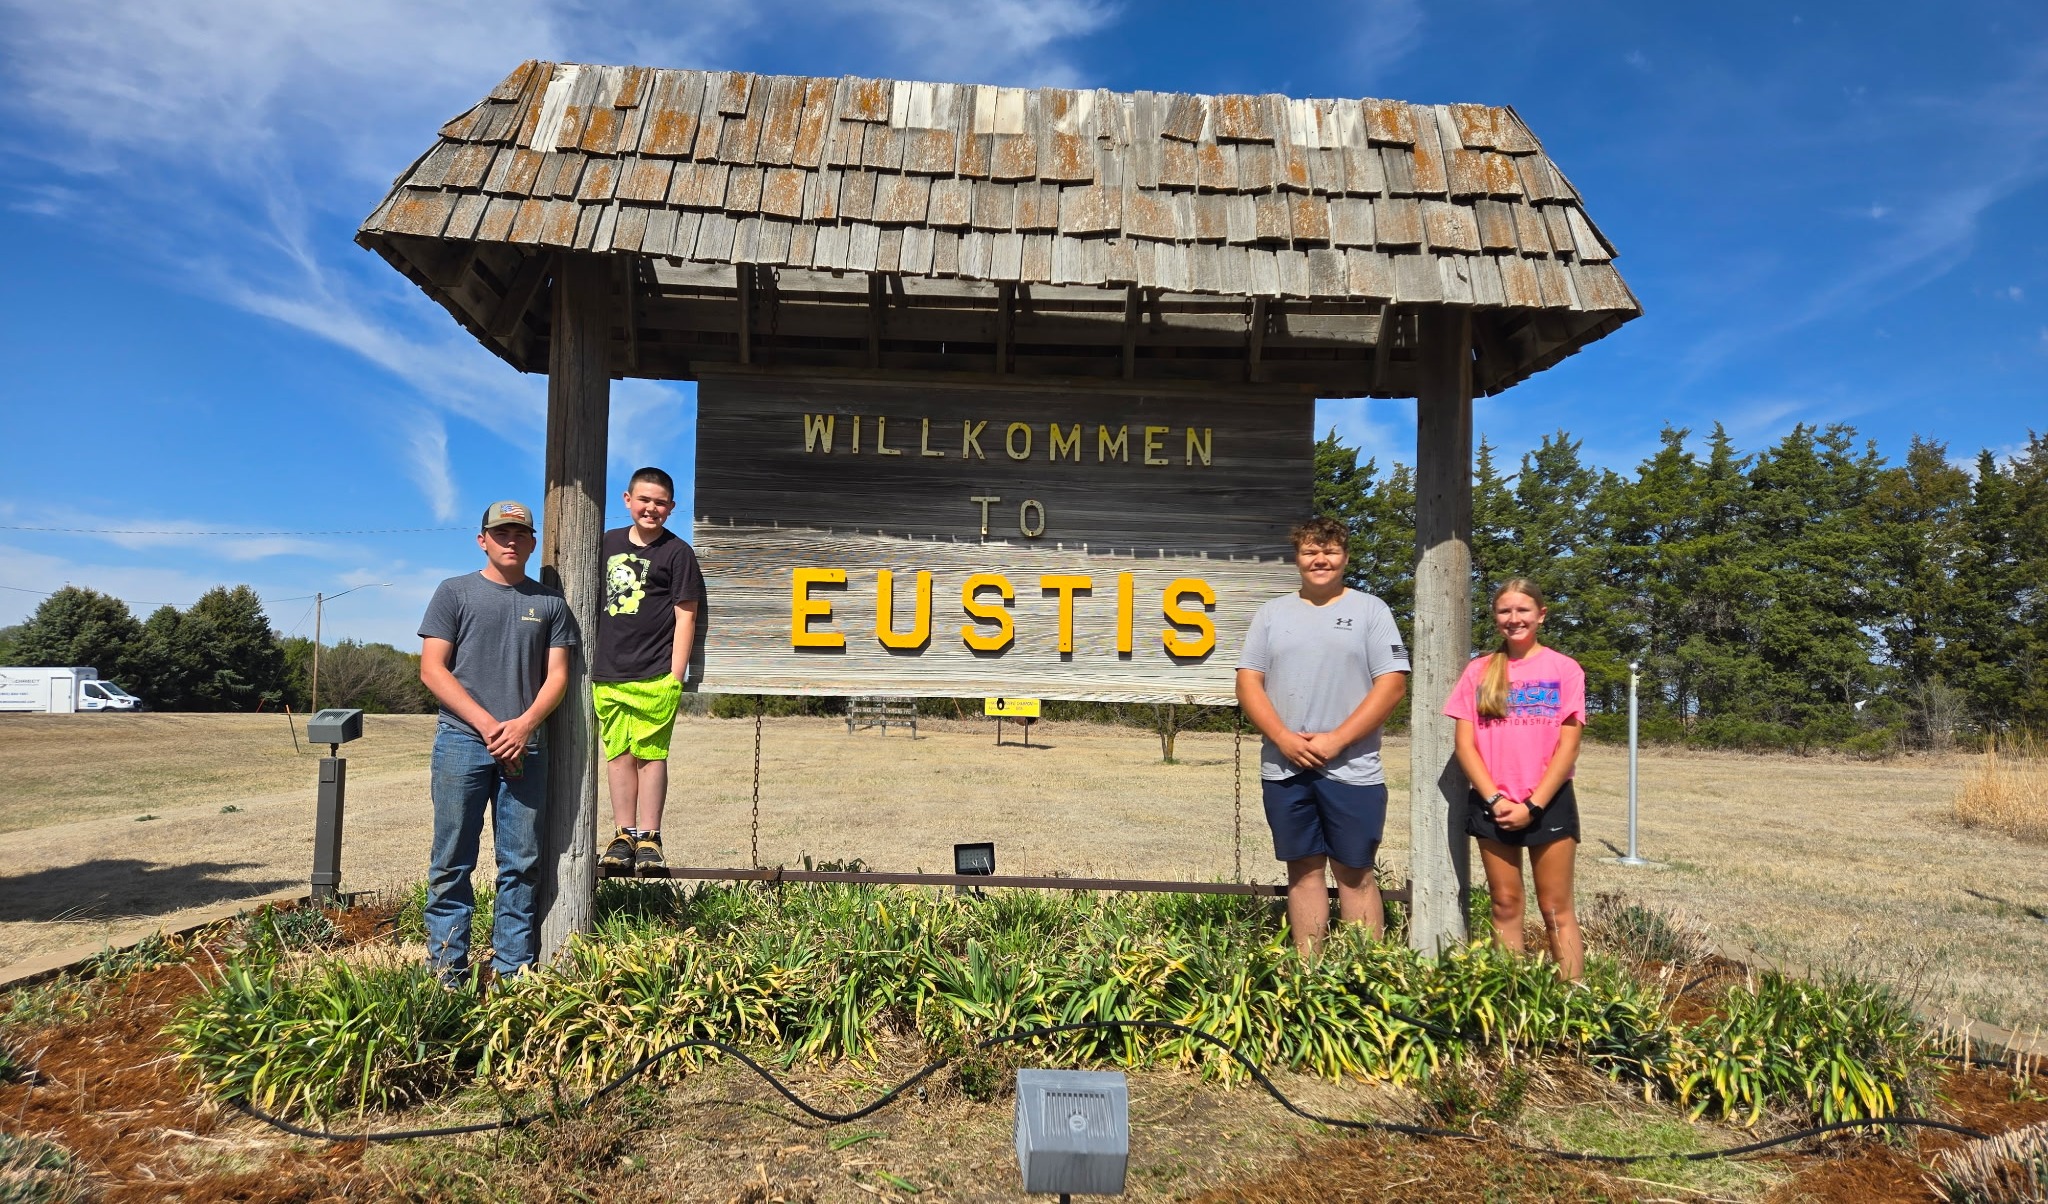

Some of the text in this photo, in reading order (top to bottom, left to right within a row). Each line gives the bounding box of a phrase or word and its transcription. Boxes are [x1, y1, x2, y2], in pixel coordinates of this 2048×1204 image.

[804, 413, 1212, 466] WILLKOMMEN
[970, 496, 1045, 537] TO
[792, 567, 1216, 658] EUSTIS
